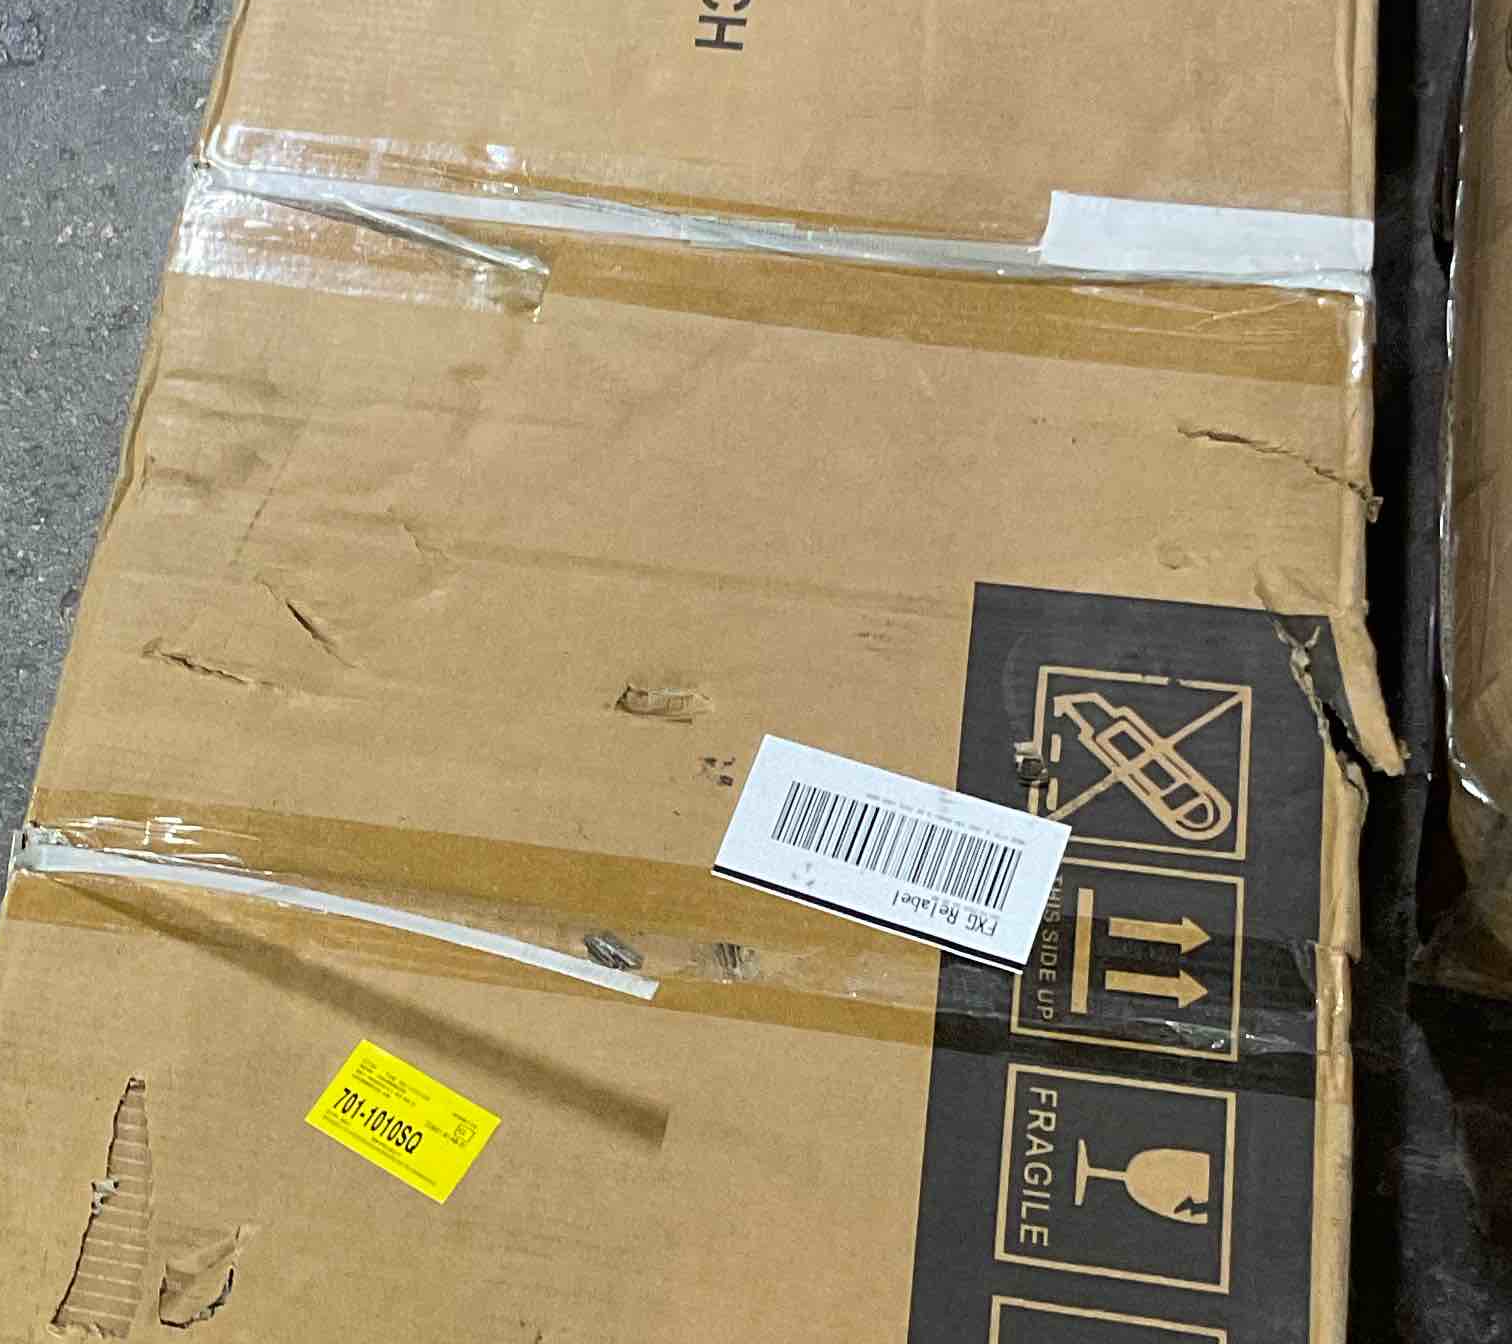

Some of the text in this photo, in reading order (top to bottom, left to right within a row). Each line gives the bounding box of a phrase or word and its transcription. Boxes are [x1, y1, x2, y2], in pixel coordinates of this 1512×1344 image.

[892, 889, 962, 927] Relabel
[966, 915, 998, 937] FXG
[1039, 929, 1060, 982] SIDE
[1037, 988, 1055, 1022] UP
[333, 1087, 423, 1154] 701-1010SQ
[1020, 1087, 1058, 1247] FRAGILE
